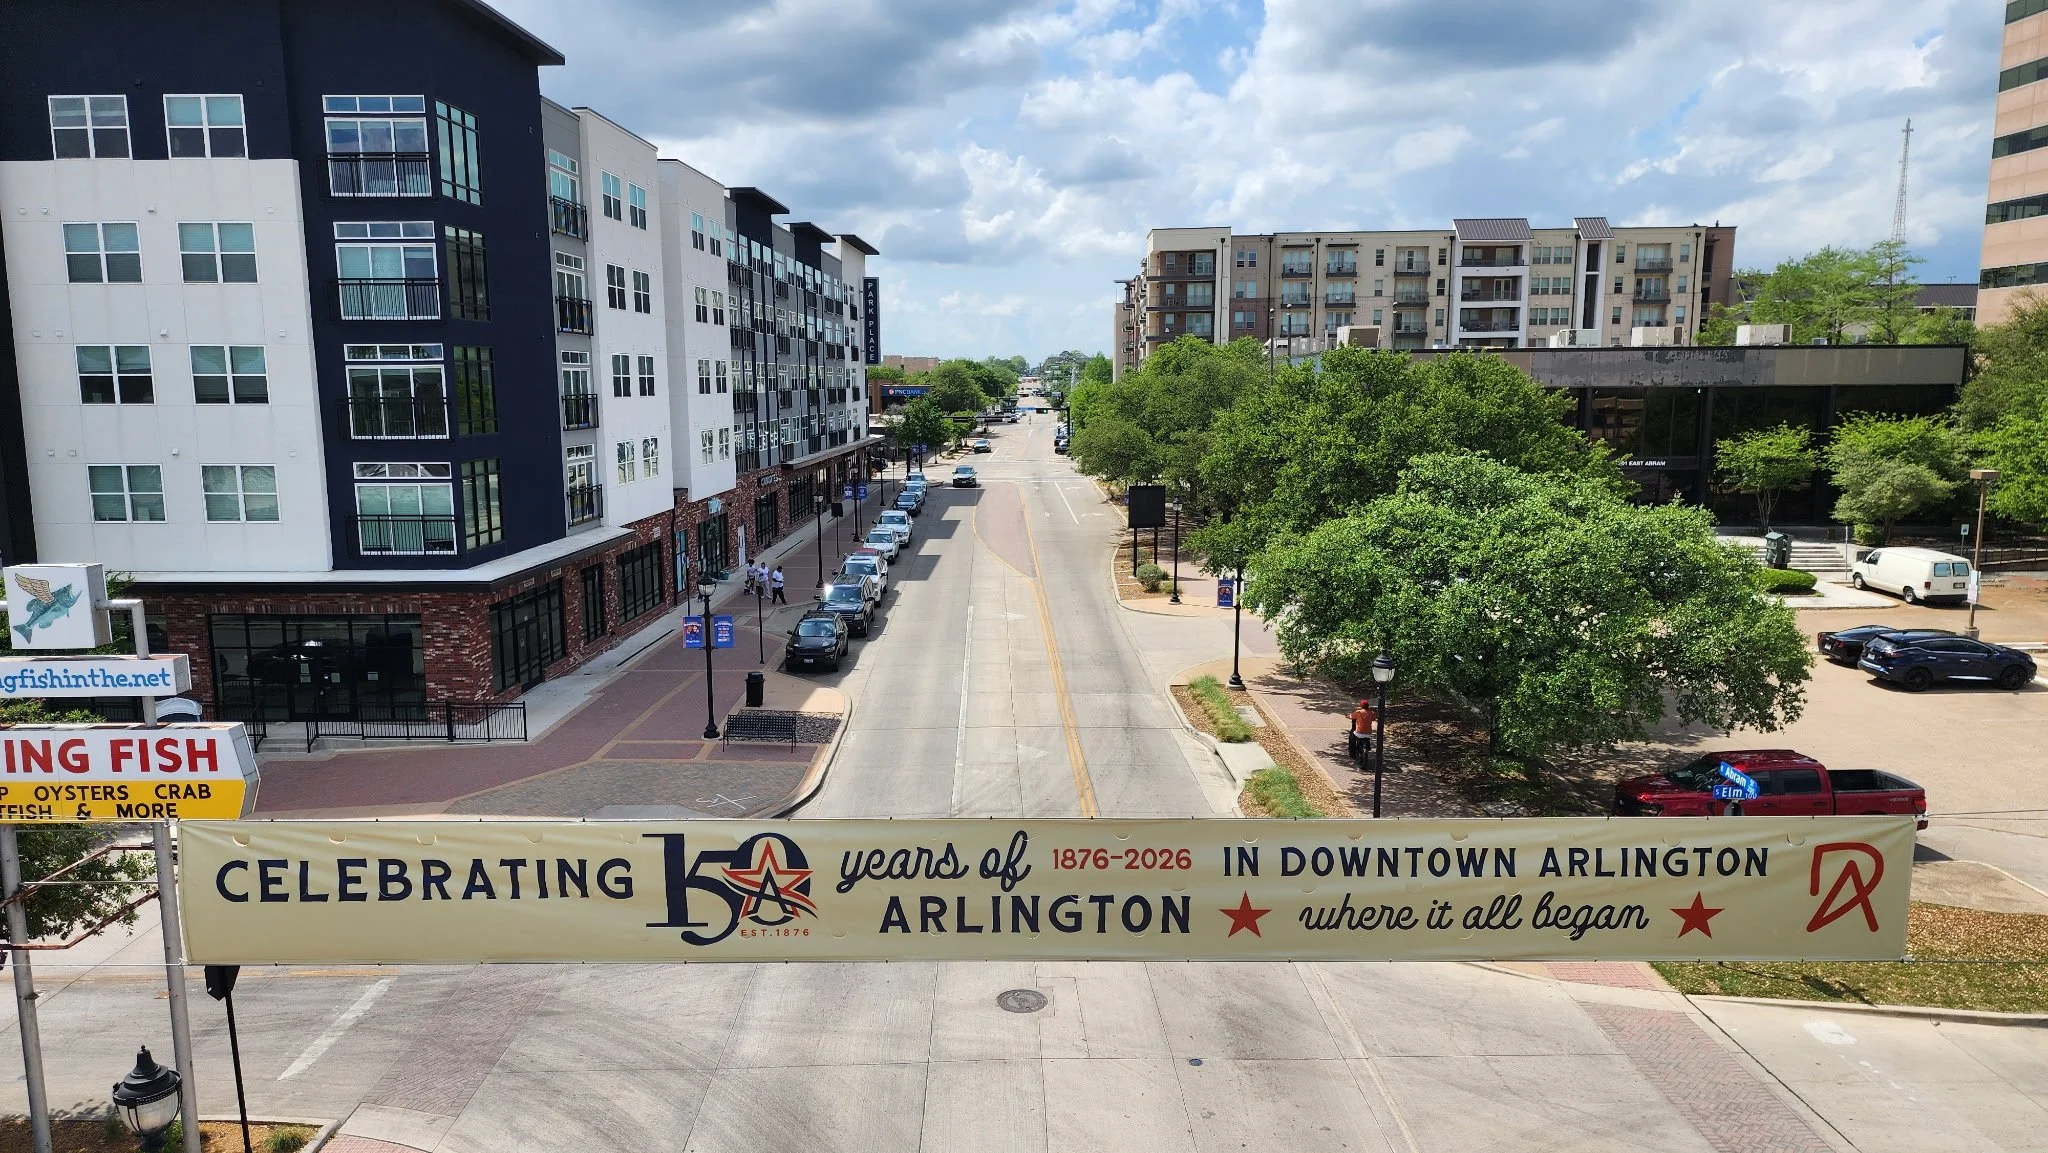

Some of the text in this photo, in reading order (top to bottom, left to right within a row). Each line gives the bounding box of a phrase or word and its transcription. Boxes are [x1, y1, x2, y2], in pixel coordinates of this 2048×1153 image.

[0, 667, 171, 693] gfishinthe.net
[109, 737, 219, 773] FISH
[1725, 766, 1747, 788] Abram
[34, 785, 129, 801] OYSTERS
[155, 783, 212, 800] CRAB
[1715, 788, 1720, 796] S
[1721, 787, 1743, 798] Elm
[76, 802, 91, 820] &
[116, 802, 179, 818] MORE
[836, 830, 1032, 893] years of
[1053, 848, 1192, 870] 1876-2026
[1223, 846, 1769, 878] IN DOWNTOWN ARLINGTON
[215, 832, 811, 946] CELEBRATING 150
[878, 894, 1191, 934] ARLINGTON
[1298, 891, 1650, 942] where it all began
[740, 928, 810, 937] EST.1876
